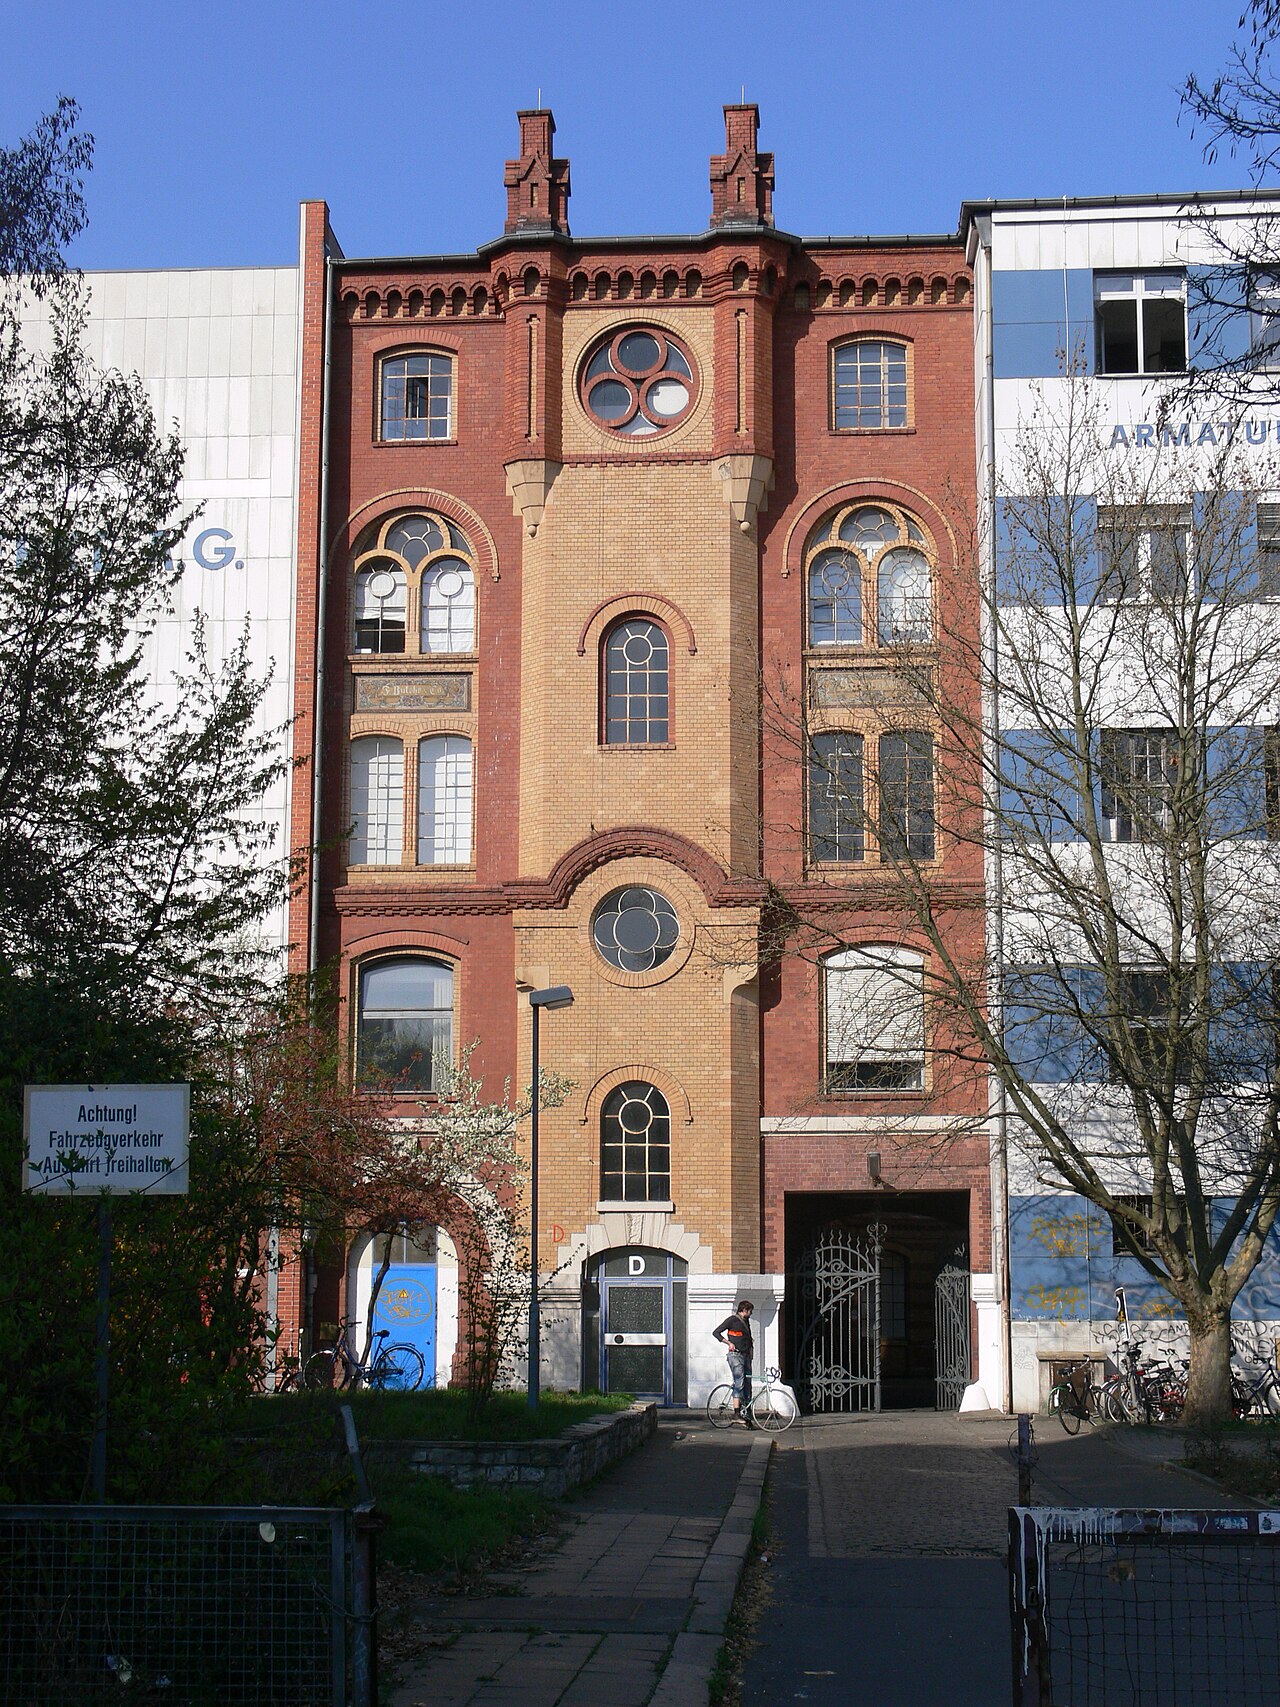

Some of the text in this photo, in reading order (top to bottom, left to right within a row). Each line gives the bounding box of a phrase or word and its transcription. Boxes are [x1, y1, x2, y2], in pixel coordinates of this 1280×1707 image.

[1109, 420, 1280, 449] ARMATU
[77, 1104, 137, 1125] Achtung!
[49, 1130, 164, 1150] Fahrzeugverkehr
[553, 1224, 565, 1243] D
[628, 1255, 646, 1276] D
